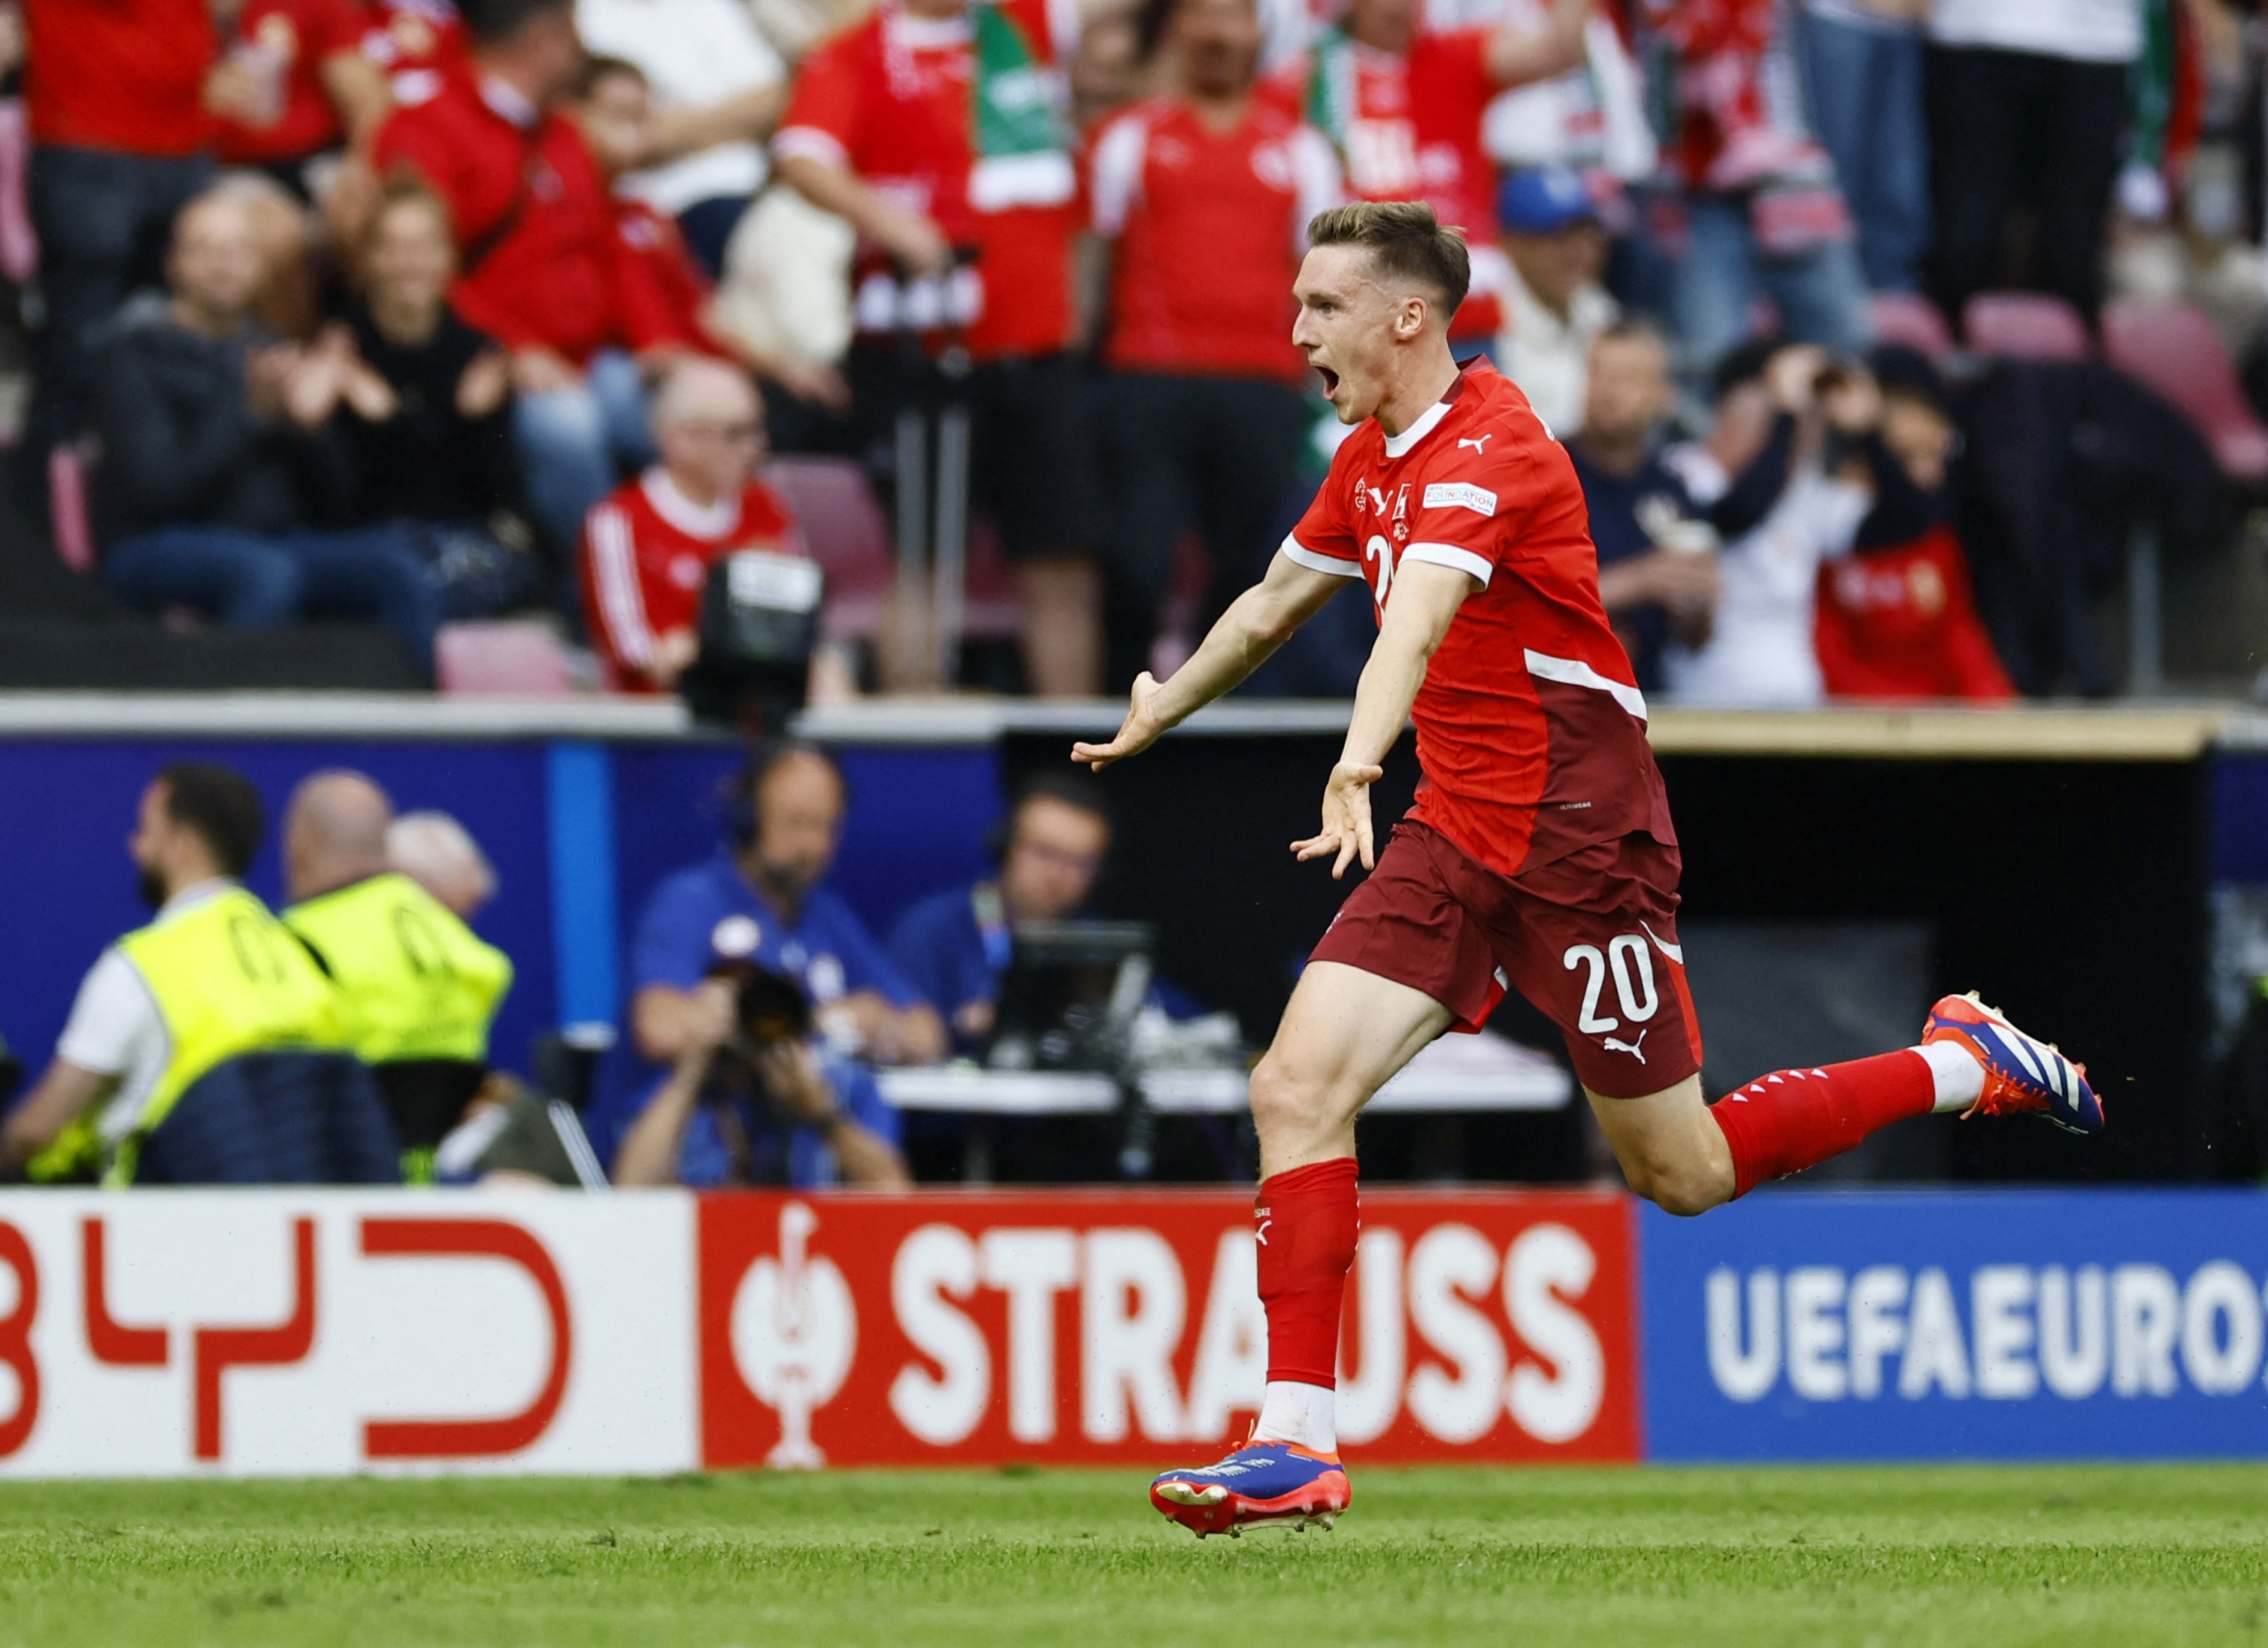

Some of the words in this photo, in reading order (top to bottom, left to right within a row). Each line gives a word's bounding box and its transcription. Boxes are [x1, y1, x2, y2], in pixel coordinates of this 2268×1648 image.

[1426, 491, 1494, 507] FOUNDATION
[1367, 535, 1394, 611] 2
[1564, 934, 1659, 1033] 20
[0, 1216, 573, 1459] YD
[889, 1222, 1606, 1447] STRAUSS
